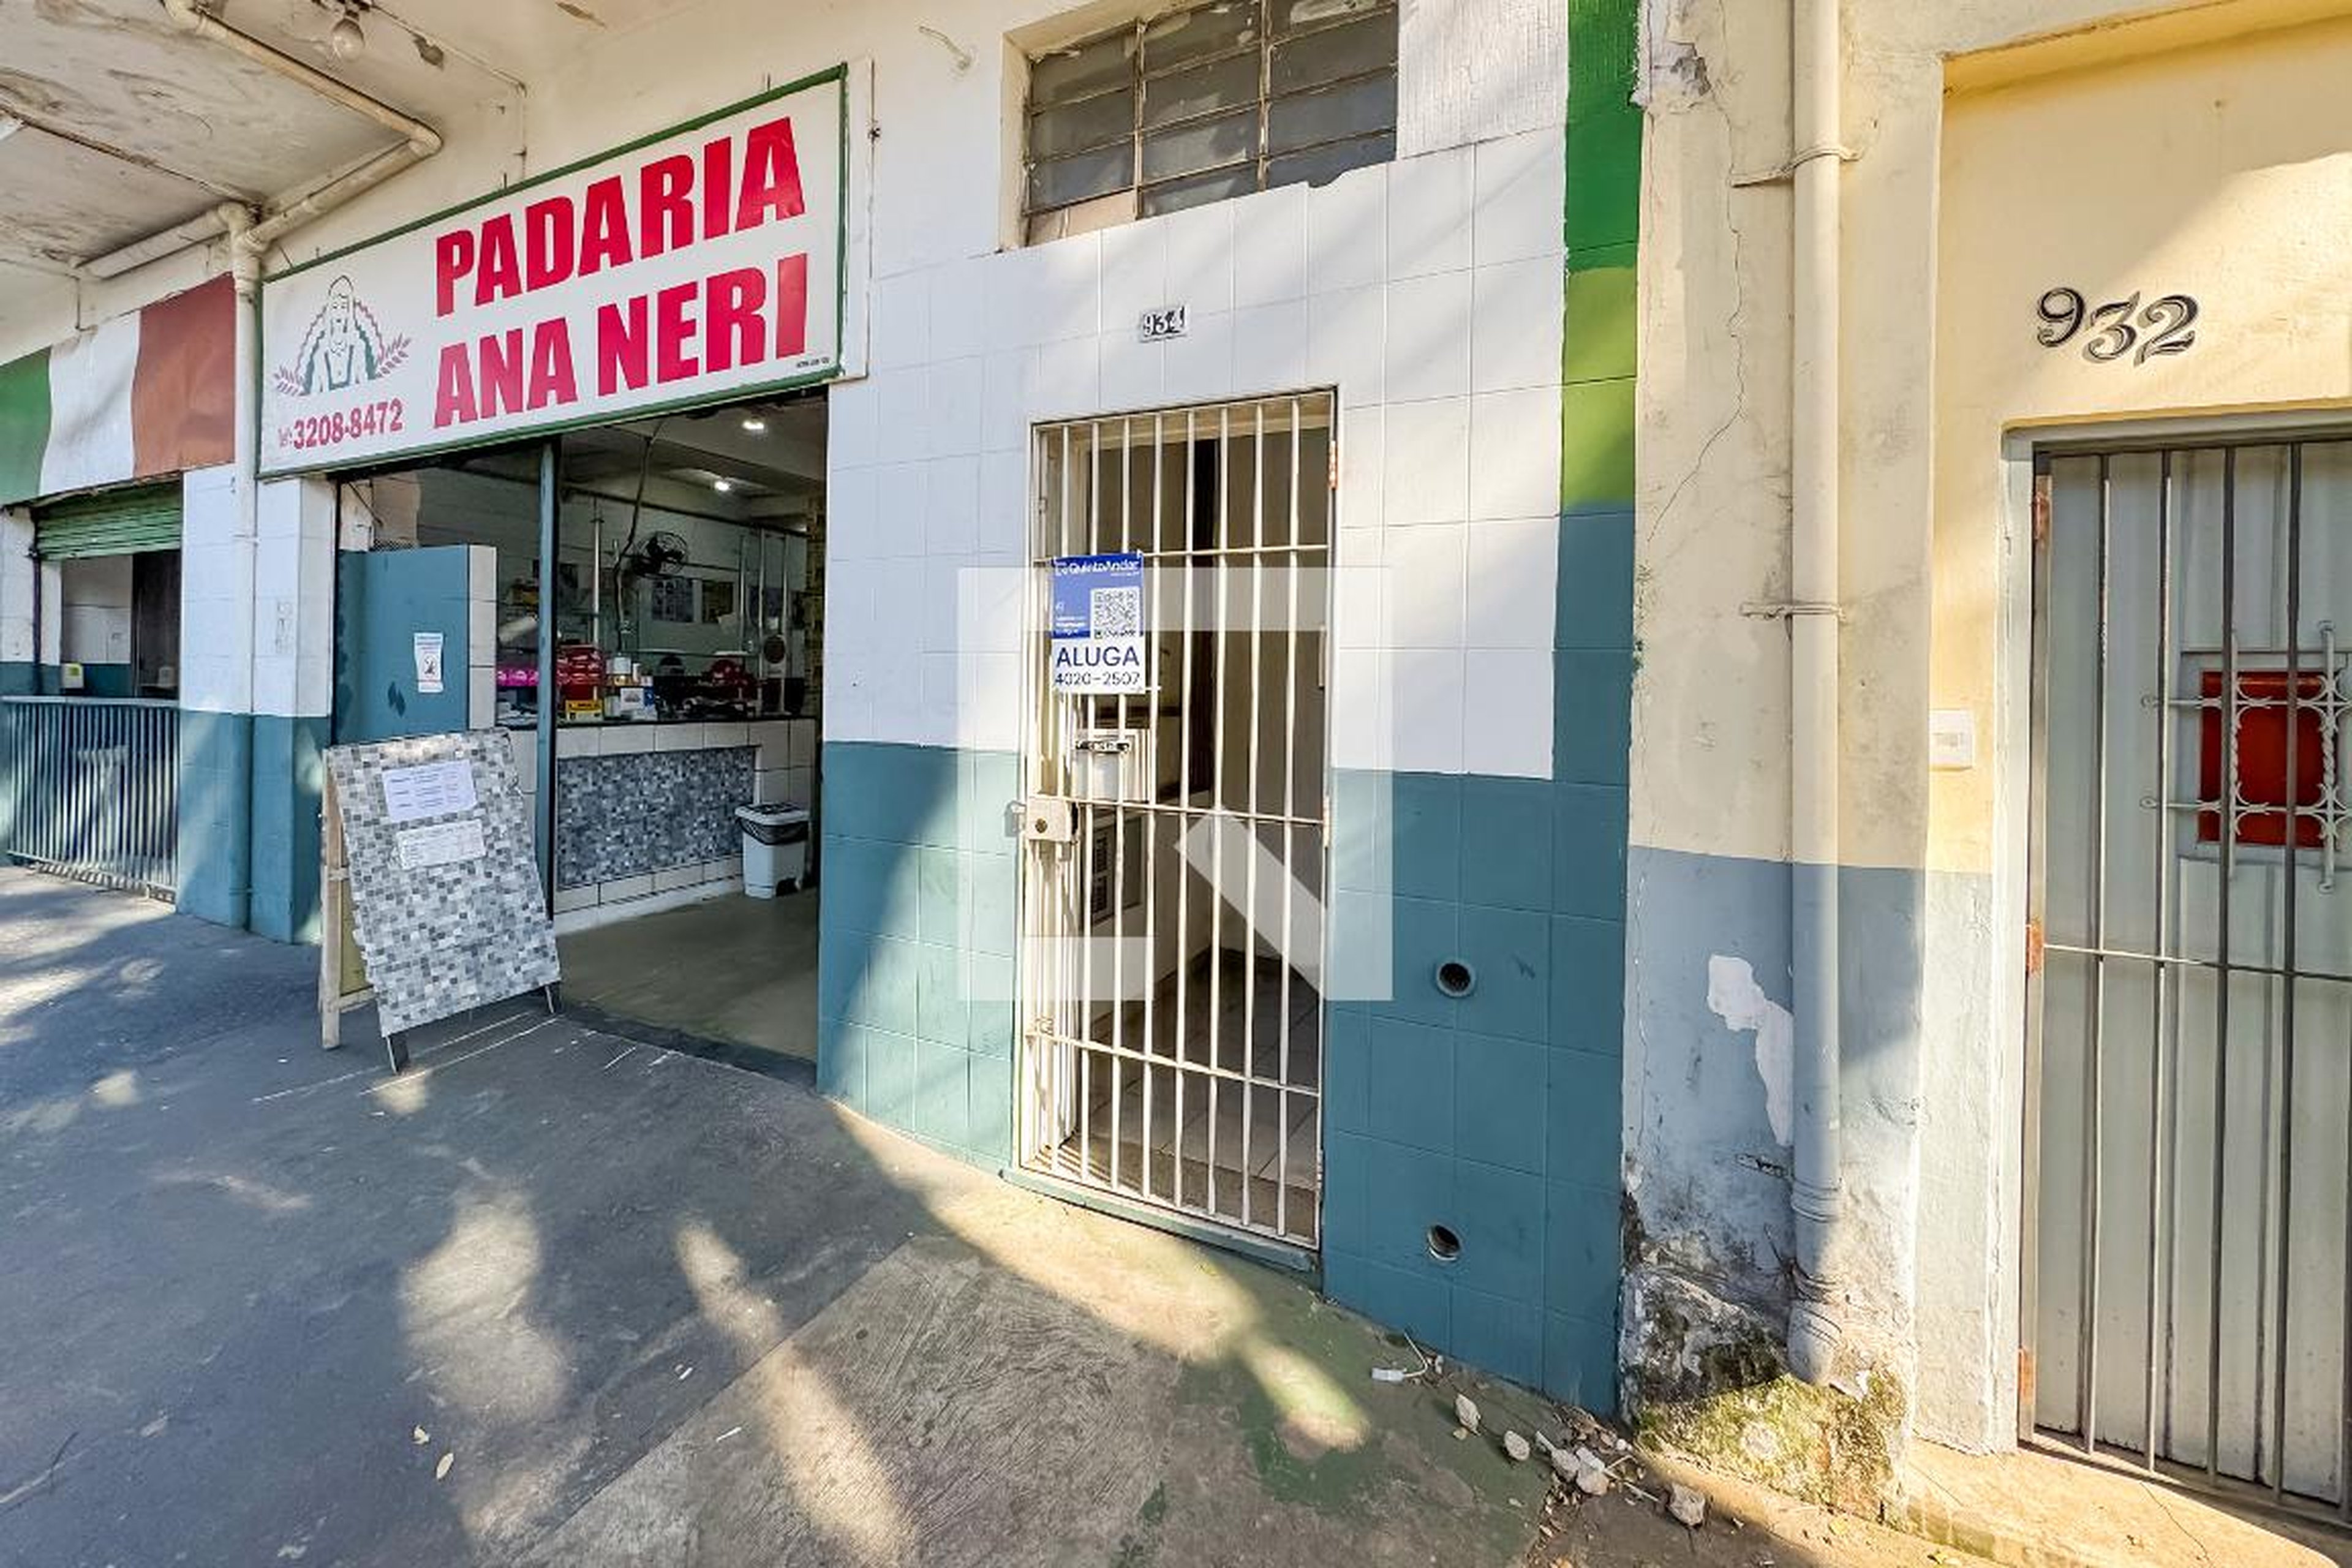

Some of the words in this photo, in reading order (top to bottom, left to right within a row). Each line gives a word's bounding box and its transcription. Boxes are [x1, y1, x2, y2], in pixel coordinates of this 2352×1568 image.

[436, 116, 805, 317] PADARIA
[434, 315, 578, 429] ANA
[598, 253, 808, 398] NERI
[2037, 287, 2198, 368] 932
[1055, 671, 1140, 687] 4020-2507
[1056, 646, 1140, 668] ALUGA
